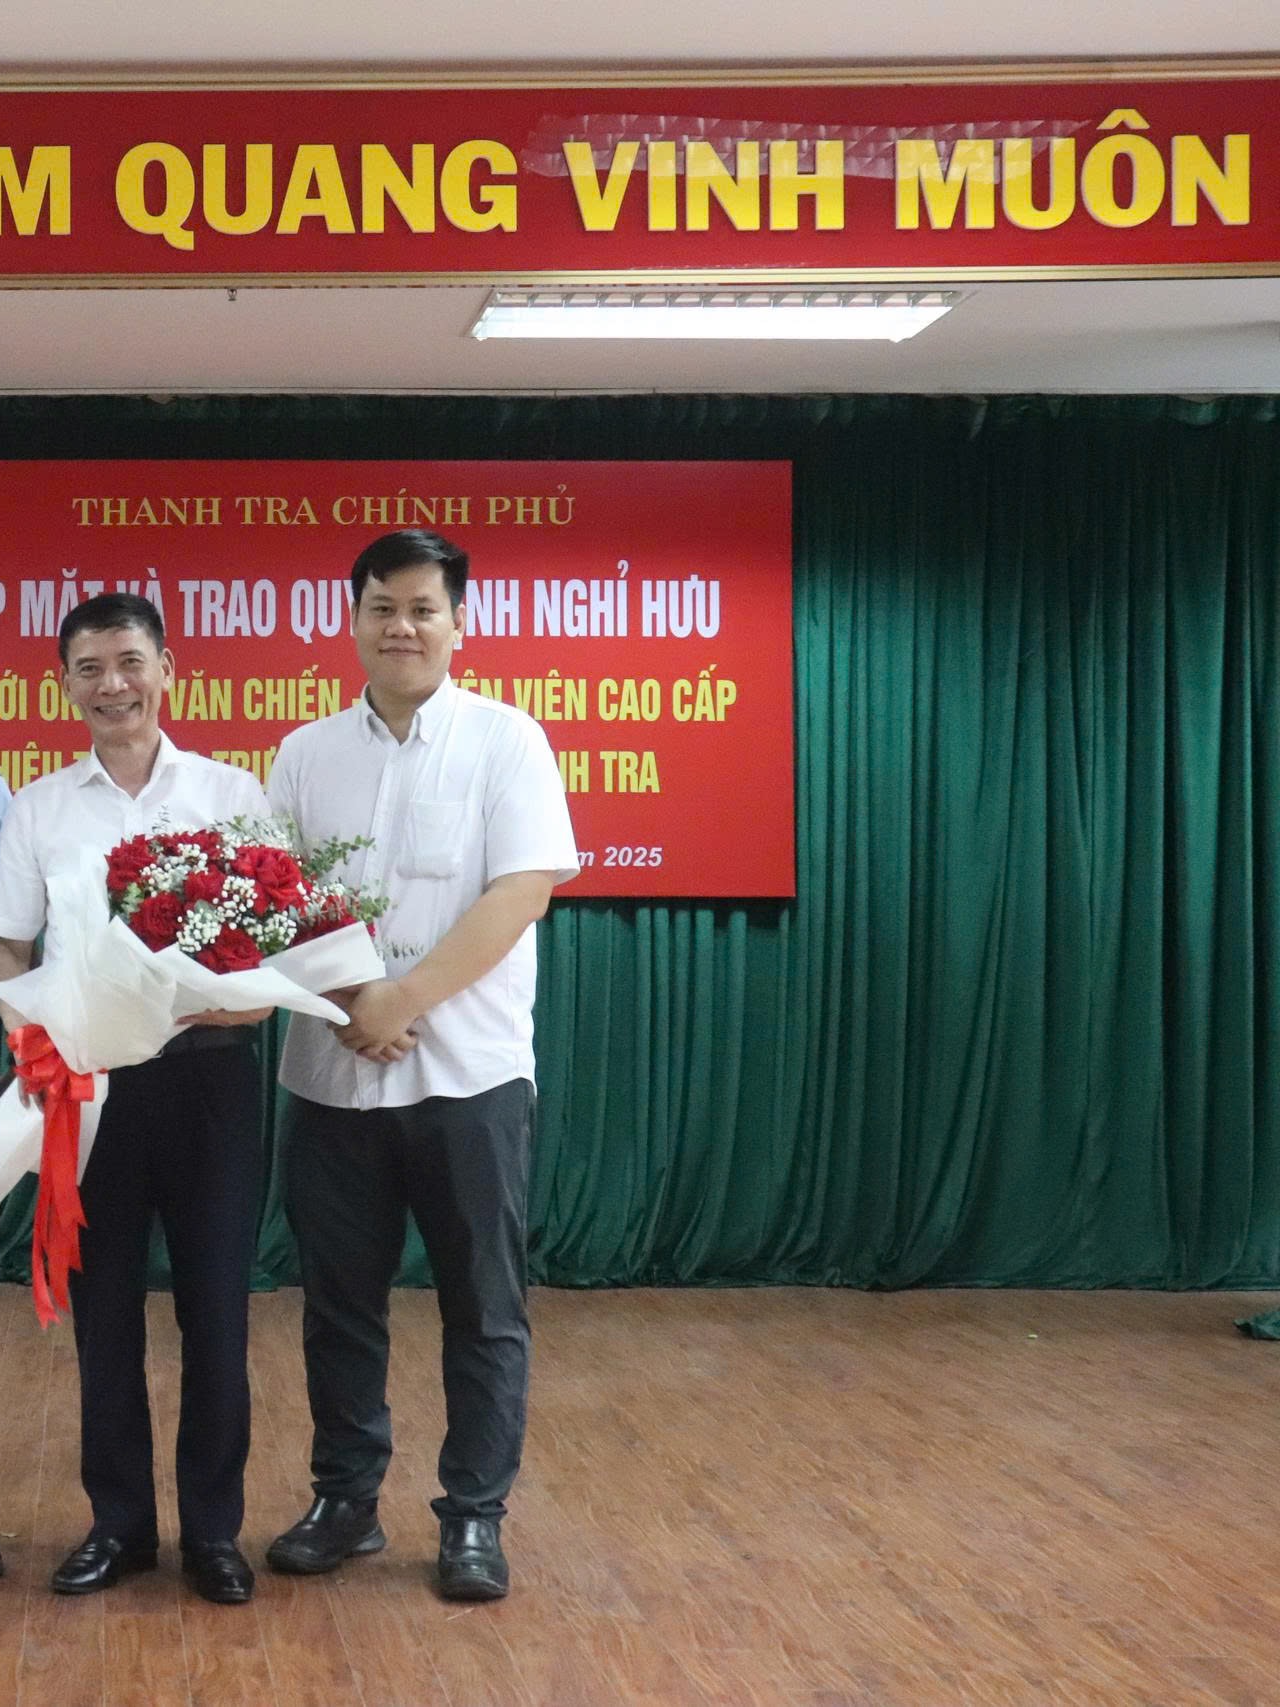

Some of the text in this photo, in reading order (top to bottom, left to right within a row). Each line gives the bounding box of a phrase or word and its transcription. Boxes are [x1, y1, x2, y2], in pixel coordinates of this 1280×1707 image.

[115, 139, 519, 250] QUANG
[564, 138, 846, 232] VINH
[895, 108, 1251, 230] MUÔN
[72, 483, 576, 525] THANH TRA CHÍNH PHỦ
[178, 579, 276, 638] TRAO
[453, 579, 520, 650] NH
[533, 559, 629, 637] NGHỈ
[641, 574, 720, 638] HƯU
[170, 669, 232, 721] VĂN
[243, 664, 341, 721] CHIẾN
[513, 669, 587, 721] VIÊN
[598, 678, 661, 721] CAO
[672, 664, 737, 721] CẤP
[600, 751, 660, 793] TRA
[603, 846, 663, 867] 2025
